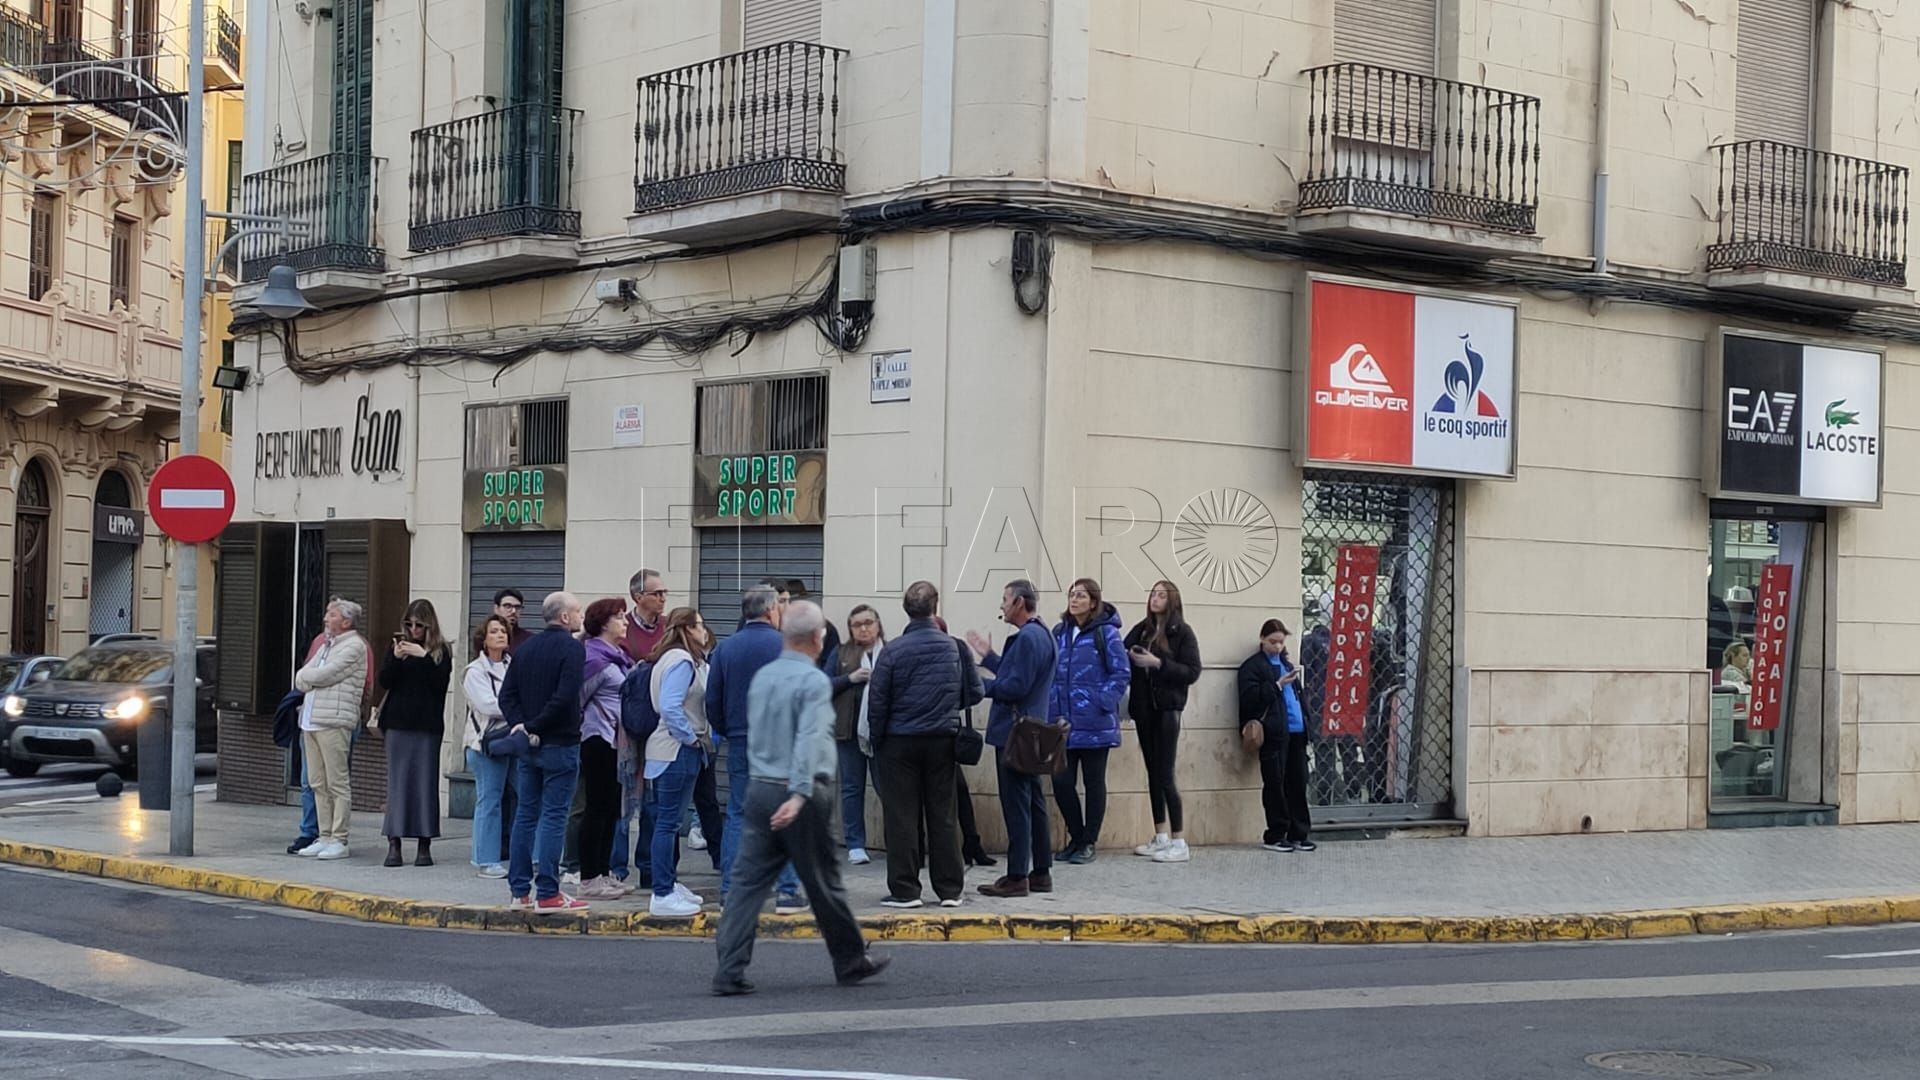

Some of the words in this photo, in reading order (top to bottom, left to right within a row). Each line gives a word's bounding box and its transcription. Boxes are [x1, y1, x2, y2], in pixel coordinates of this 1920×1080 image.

[1424, 412, 1436, 432] le
[1438, 417, 1463, 439] coq
[1465, 418, 1508, 440] sportif
[1728, 387, 1797, 434] EA7
[255, 426, 344, 480] PERFUMERIA
[1806, 430, 1876, 455] LACOSTE
[483, 470, 545, 498] SUPER
[719, 455, 797, 486] SUPER
[483, 498, 545, 526] SPORT
[718, 487, 797, 518] SPORT
[1349, 575, 1370, 704] TOTAL
[1753, 568, 1774, 727] LIQUIDACIÓN
[1768, 591, 1787, 704] TOTAL
